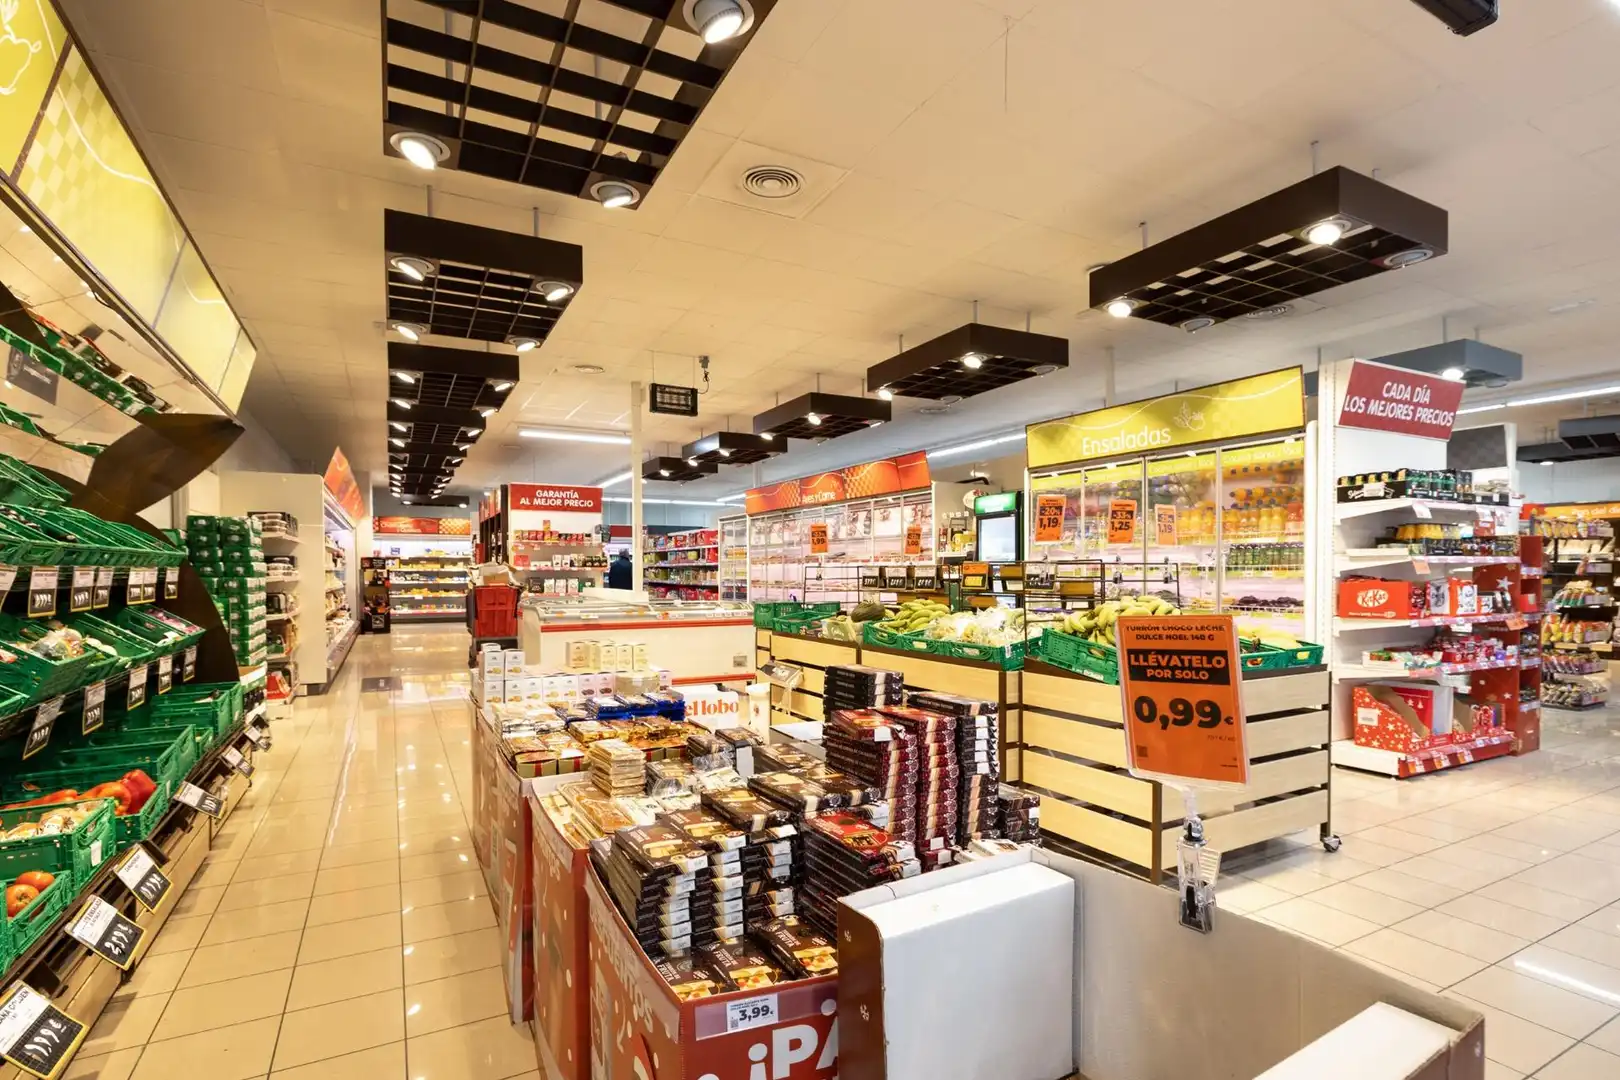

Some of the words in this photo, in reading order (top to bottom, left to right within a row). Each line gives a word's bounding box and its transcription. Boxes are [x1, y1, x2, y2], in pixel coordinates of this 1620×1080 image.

[1382, 381, 1412, 401] CADA
[1413, 384, 1431, 404] DÍA
[1344, 394, 1366, 414] LOS
[1367, 399, 1415, 421] MEJORES
[1414, 407, 1455, 427] PRECIOS
[1082, 425, 1172, 456] Ensaladas
[520, 497, 531, 505] AL
[533, 498, 562, 507] MEJOR
[564, 499, 594, 508] PRECIO
[536, 489, 579, 499] GARANTÍA
[1135, 633, 1164, 641] DULCE
[1165, 633, 1189, 641] NOEL
[1130, 650, 1227, 669] LLÉVATELO
[1146, 669, 1172, 679] POR
[1174, 669, 1209, 681] SOLO
[701, 698, 739, 716] lobo
[775, 931, 795, 948] FRUTA
[712, 950, 731, 968] FRUTA
[656, 964, 675, 982] FRUTA
